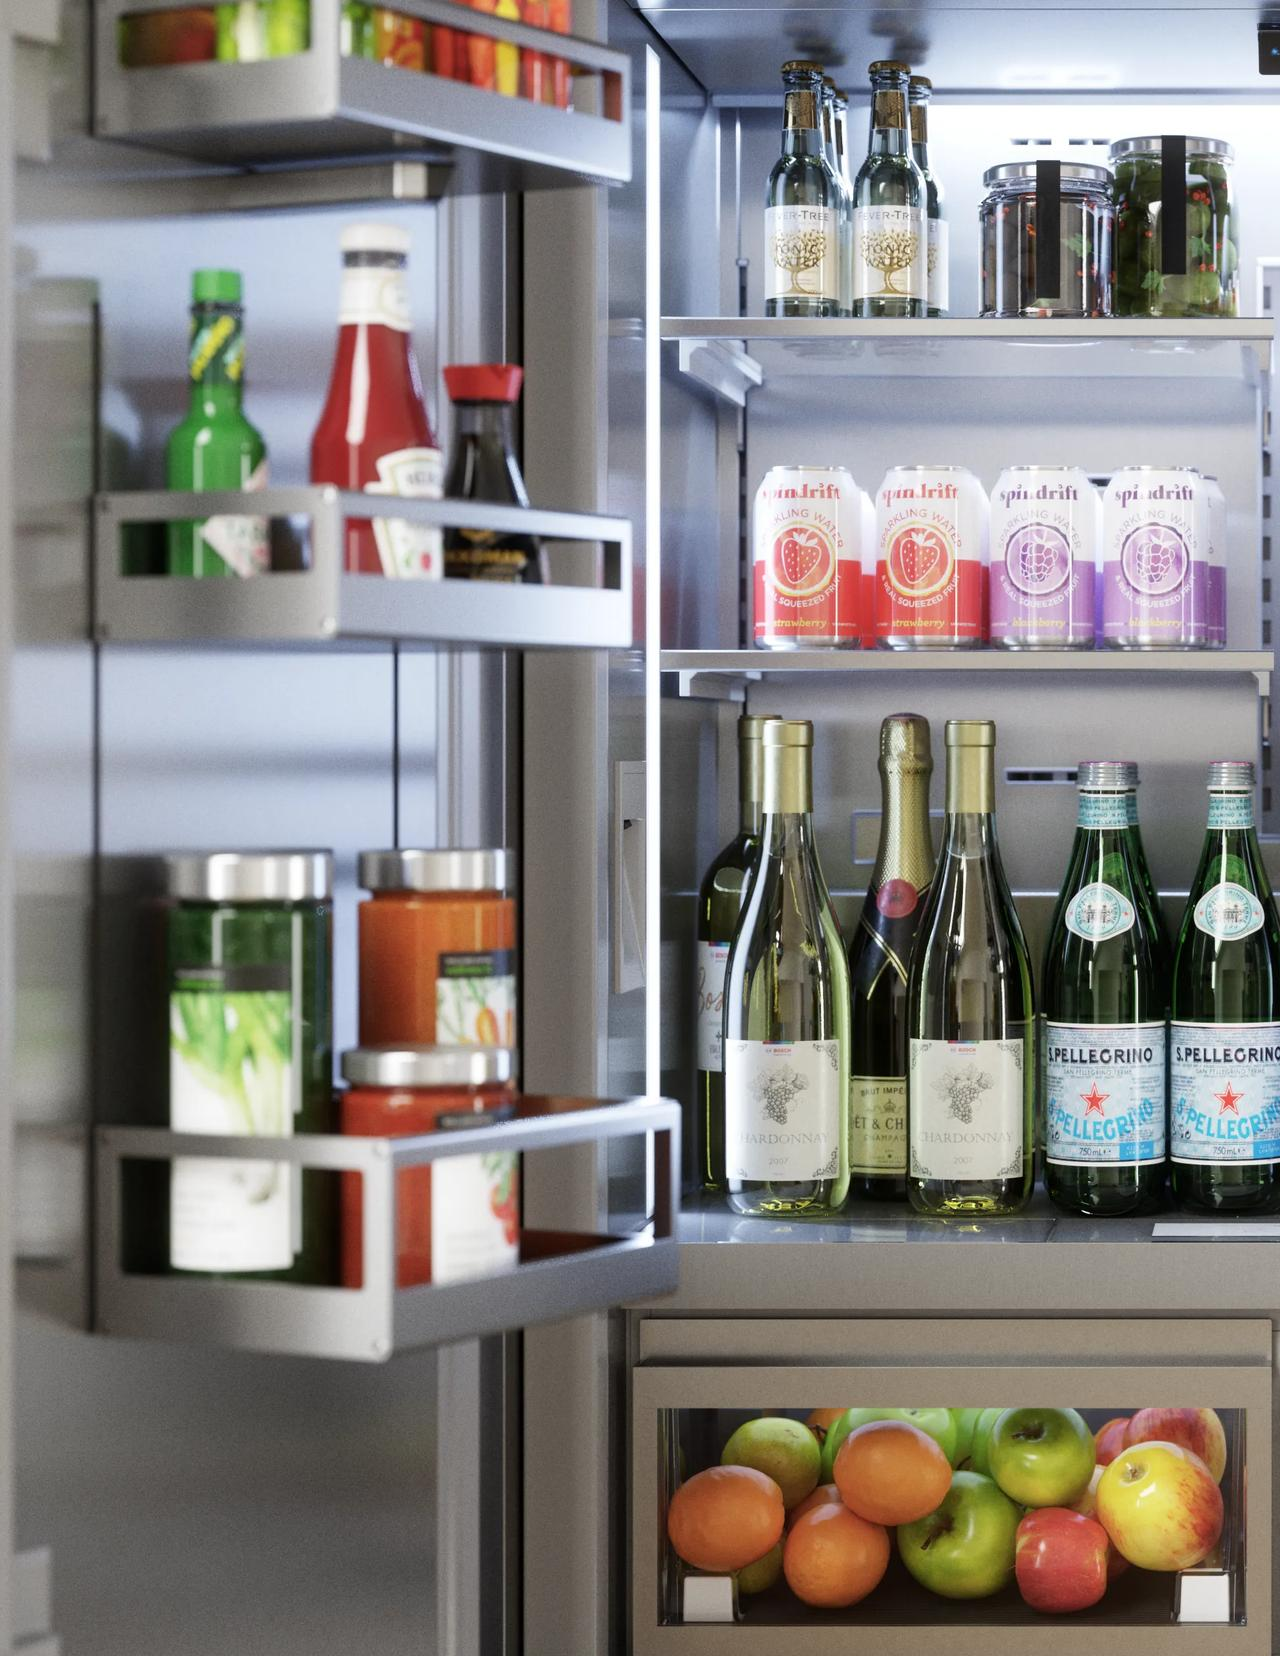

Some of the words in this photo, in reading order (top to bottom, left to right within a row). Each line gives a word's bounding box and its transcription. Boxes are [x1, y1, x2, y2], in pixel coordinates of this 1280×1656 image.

[896, 594, 944, 609] SQUEEZED
[892, 616, 946, 630] strawberry
[1047, 1047, 1154, 1065] S.PELLEGRINO
[872, 1118, 881, 1130] &
[740, 1132, 829, 1145] HARDONNAY
[919, 1131, 1012, 1145] CHARDONNAY
